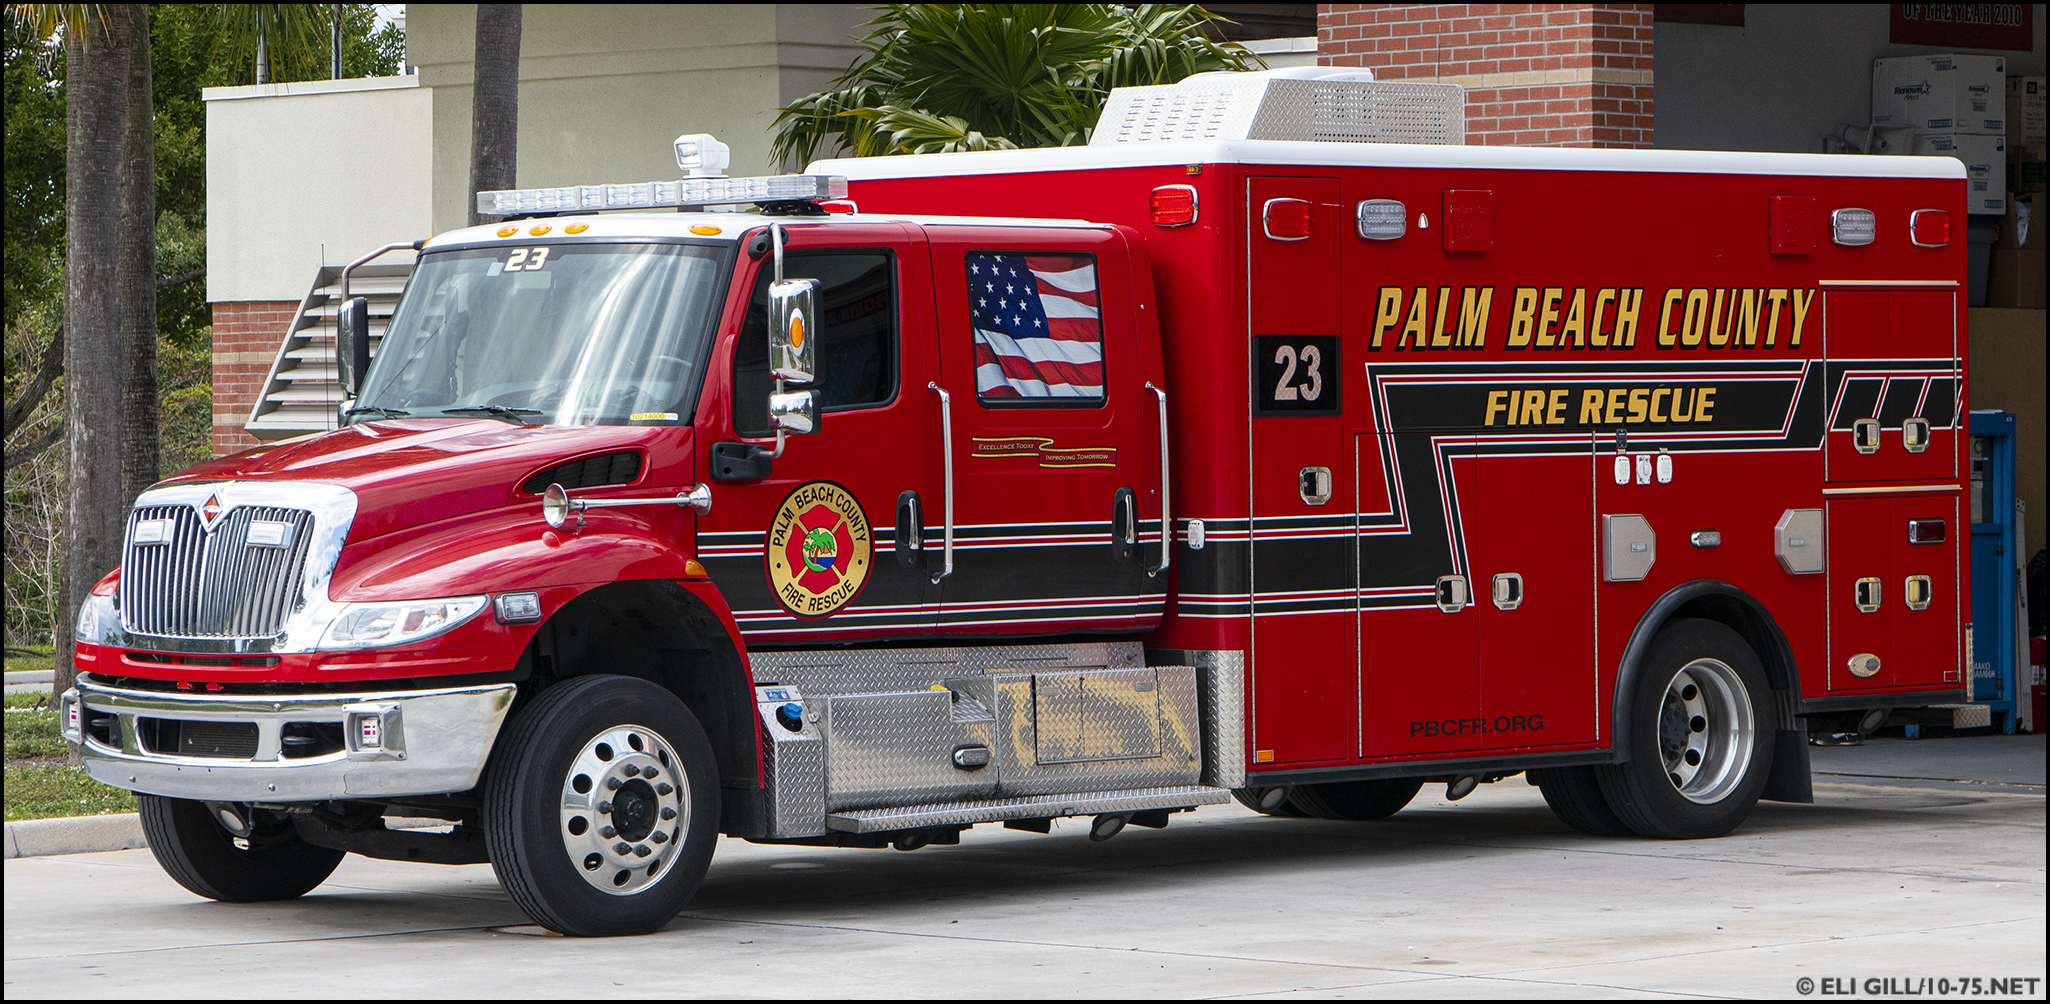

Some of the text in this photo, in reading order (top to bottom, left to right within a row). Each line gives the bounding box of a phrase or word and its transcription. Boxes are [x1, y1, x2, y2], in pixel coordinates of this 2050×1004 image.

[1925, 4, 1952, 22] THE
[1956, 4, 1990, 24] YEAR
[1993, 4, 2023, 26] 2010
[1894, 87, 1922, 95] Renown
[503, 247, 550, 273] 23
[1367, 285, 1816, 351] PALM BEACH COUNTY
[1274, 344, 1322, 401] 23
[1484, 387, 1717, 426] FIRE RESCUE
[772, 486, 867, 547] PALM BEACH COUNTY
[781, 579, 855, 612] FIRE RESCUE
[1410, 714, 1544, 738] PBCFR.ORG
